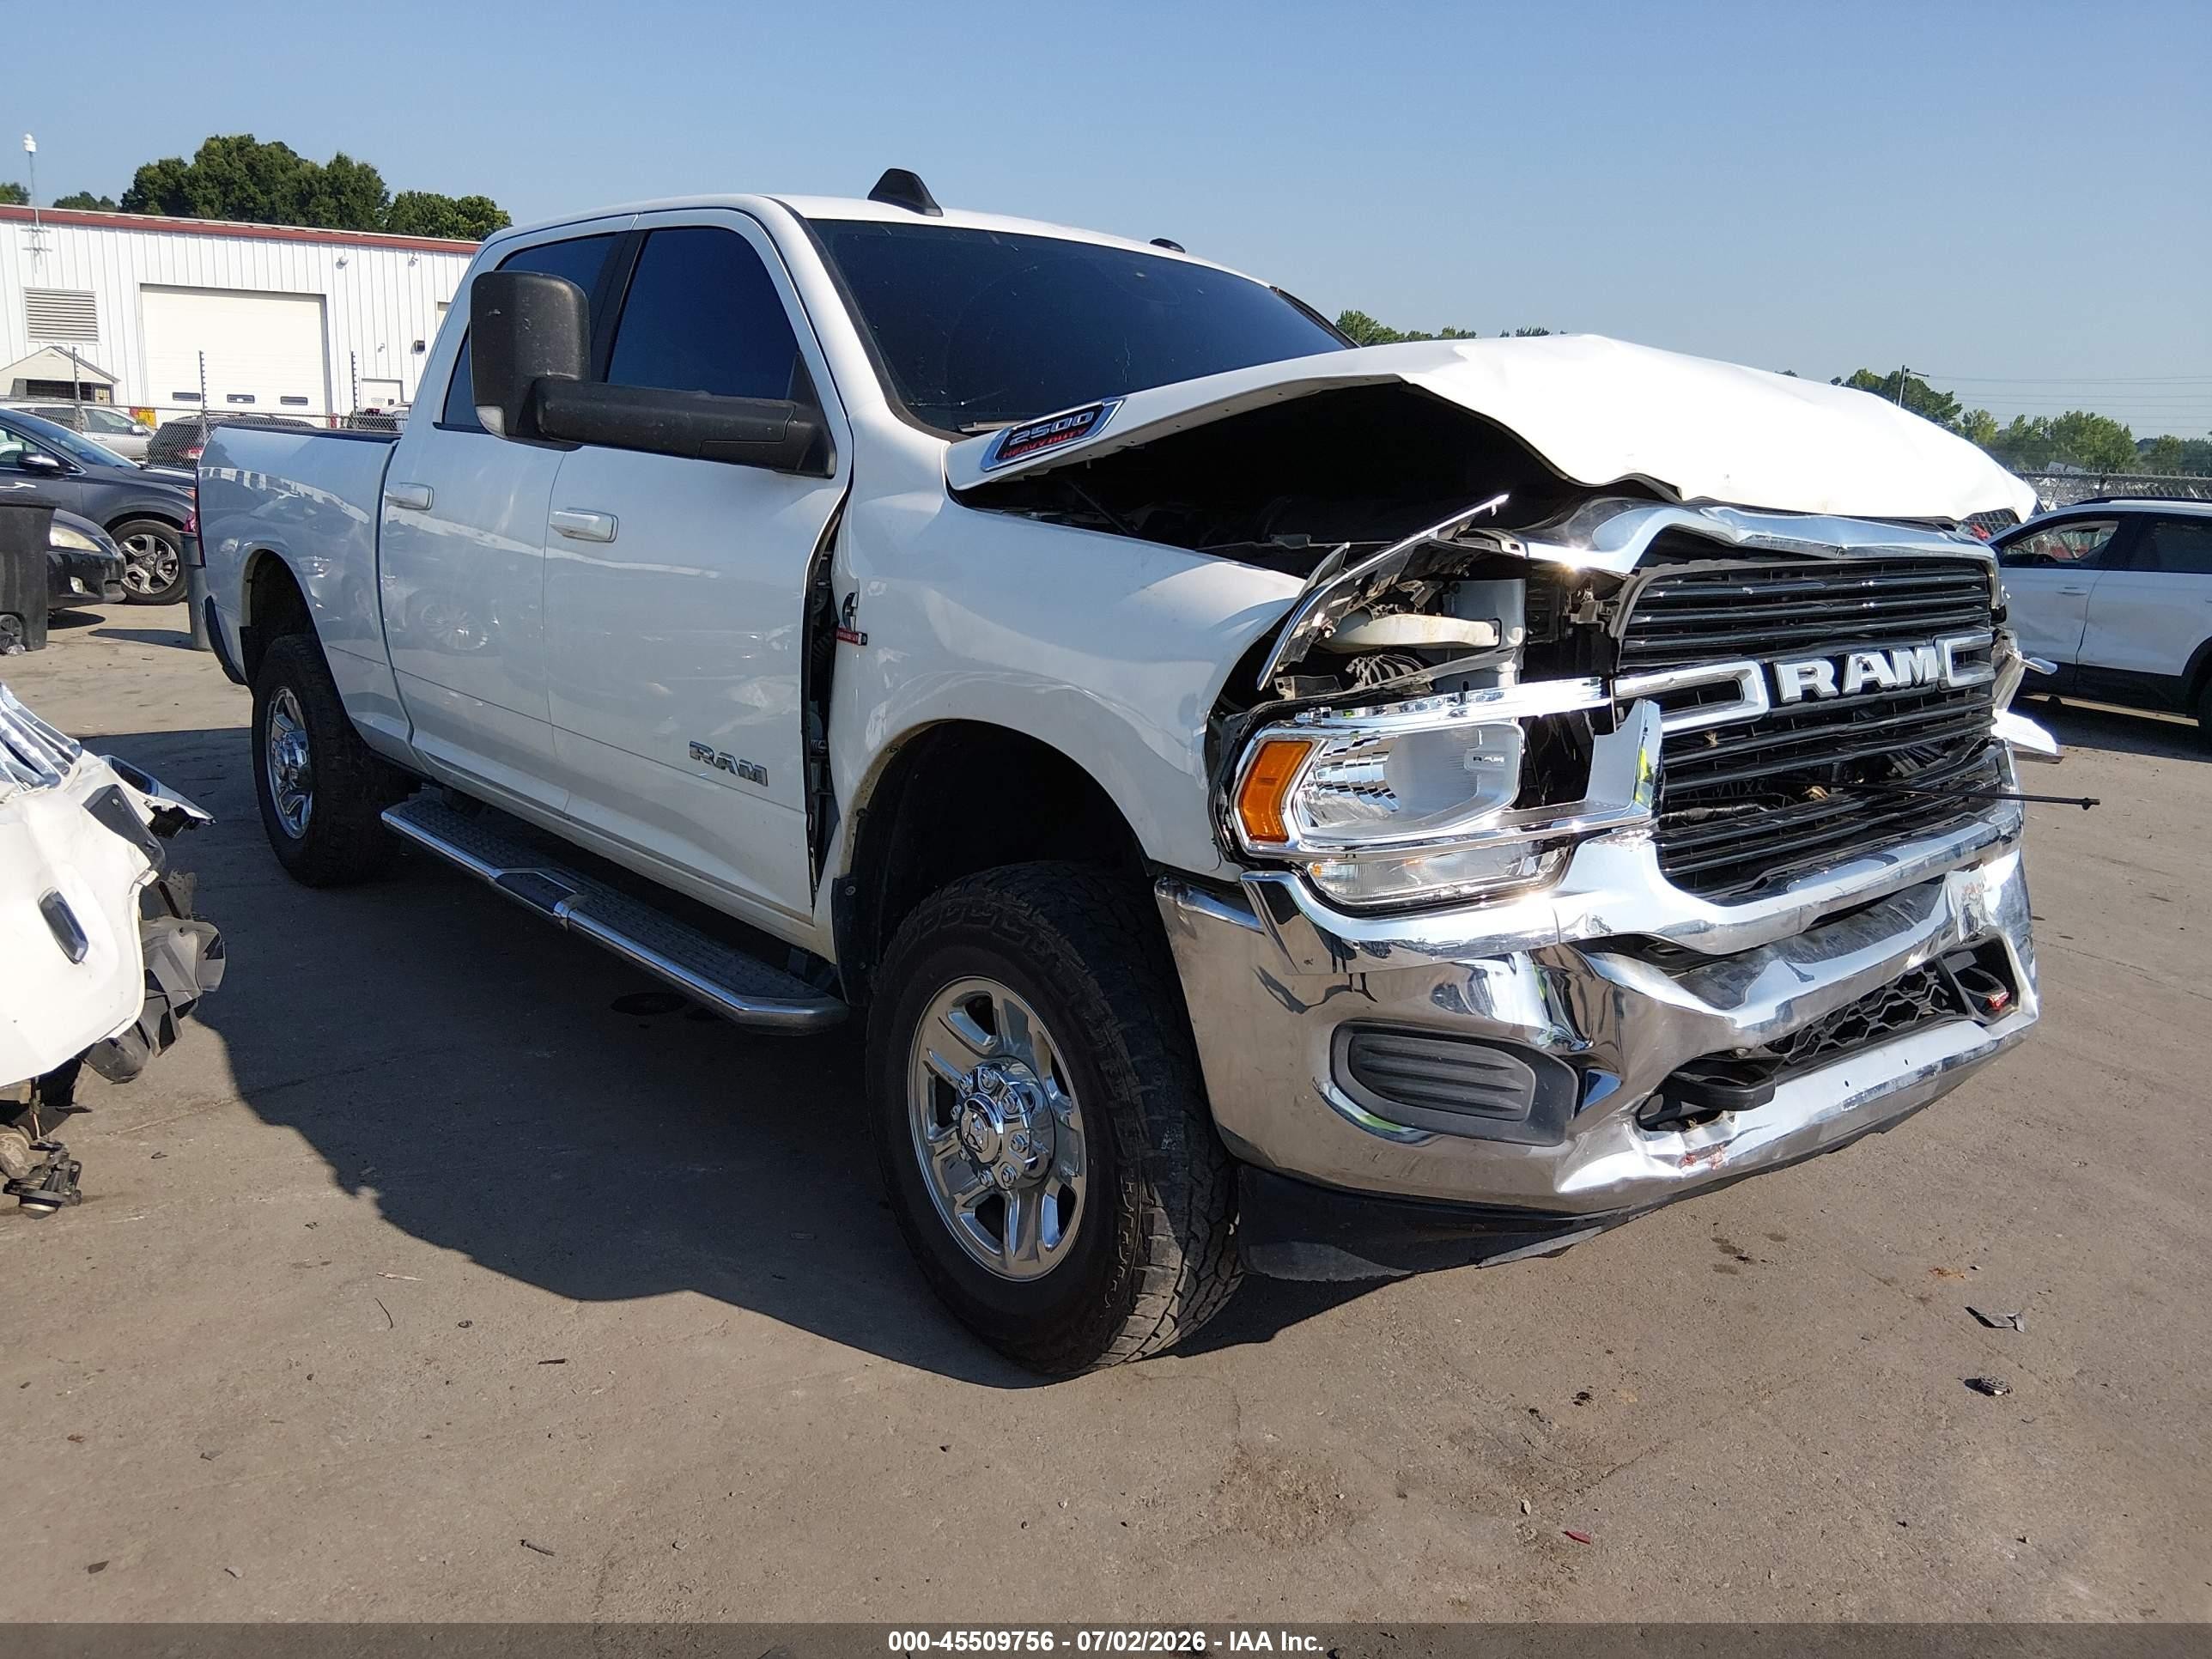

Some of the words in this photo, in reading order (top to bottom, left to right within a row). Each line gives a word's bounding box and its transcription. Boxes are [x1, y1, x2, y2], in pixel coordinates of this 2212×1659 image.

[1003, 438, 1046, 459] HEAVY
[1008, 411, 1095, 447] 2500
[1774, 647, 1939, 702] RAM
[689, 740, 769, 787] RAM
